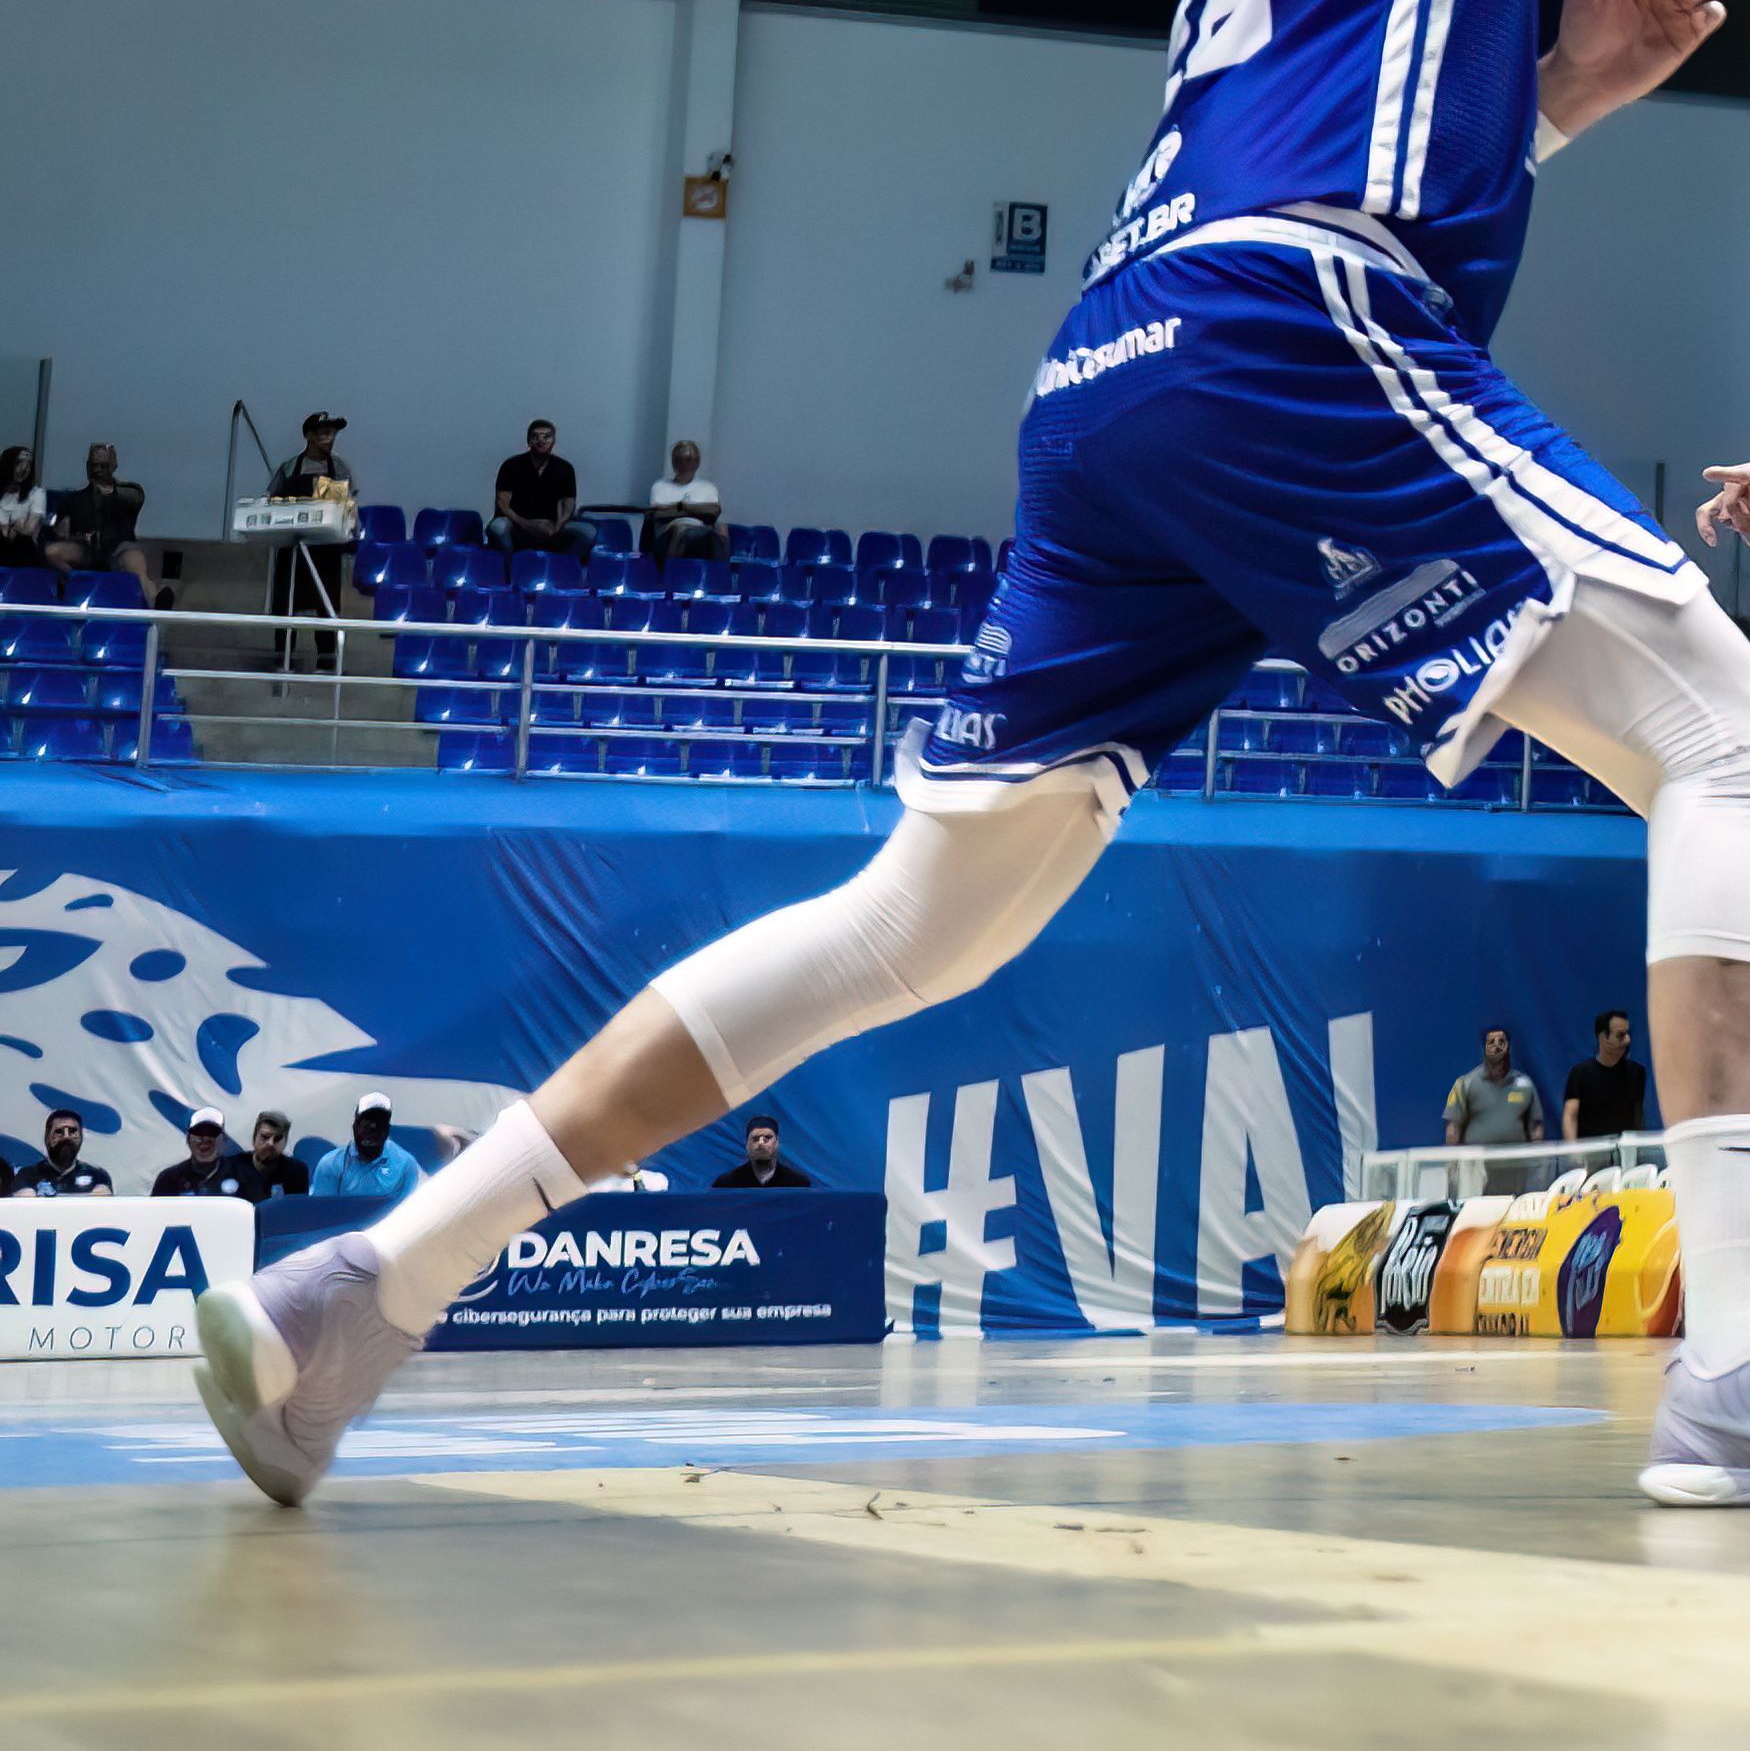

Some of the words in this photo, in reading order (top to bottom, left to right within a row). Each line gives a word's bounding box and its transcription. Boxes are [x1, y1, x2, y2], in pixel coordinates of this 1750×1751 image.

[1383, 605, 1522, 726] PHOLIA
[508, 1229, 760, 1268] DANRESA
[597, 1308, 633, 1325] para
[721, 1304, 752, 1319] sua
[757, 1303, 832, 1321] empresa
